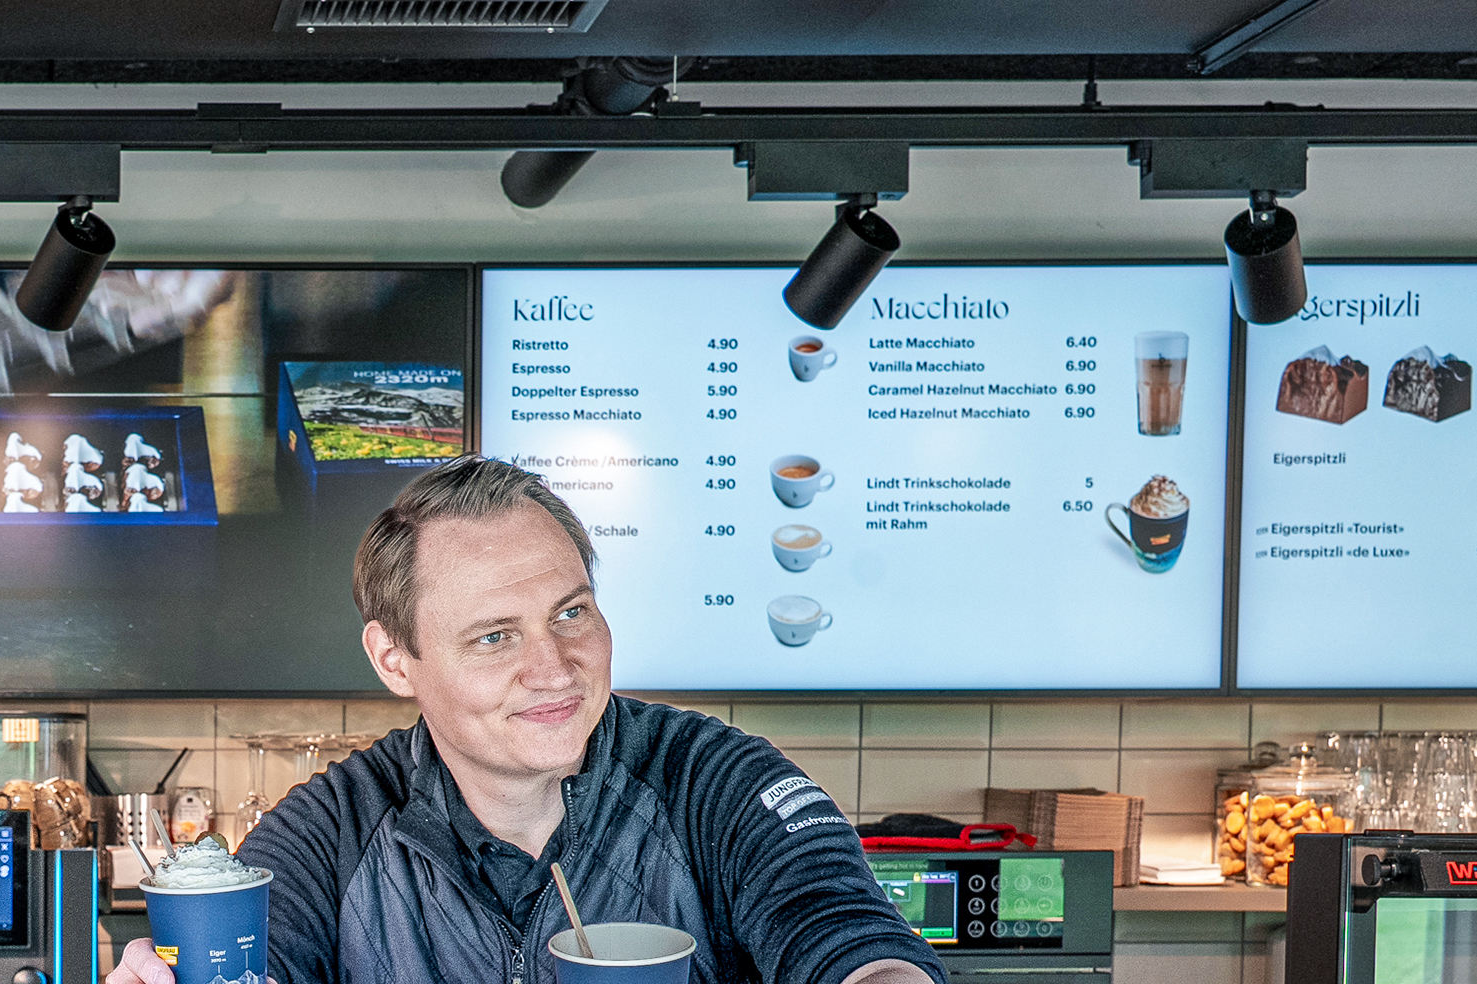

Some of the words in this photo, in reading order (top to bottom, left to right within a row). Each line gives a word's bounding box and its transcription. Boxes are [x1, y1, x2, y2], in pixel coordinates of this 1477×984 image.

[513, 295, 595, 321] Kaffee
[871, 294, 1009, 320] Macchiato
[1292, 291, 1420, 325] gerspitzli
[512, 339, 569, 351] Ristretto
[707, 338, 738, 350] 4.90
[869, 338, 903, 349] Latte
[906, 337, 975, 349] Macchiato
[1066, 336, 1097, 348] 6.40
[512, 363, 571, 375] Espresso
[707, 362, 738, 373] 4.90
[869, 361, 913, 372] Vanilla
[916, 360, 985, 372] Macchiato
[1066, 360, 1097, 372] 6.90
[354, 369, 393, 378] HOME
[399, 369, 436, 377] MADE
[375, 375, 449, 384] 2320m
[511, 385, 577, 398] Doppelter
[580, 386, 639, 398] Espresso
[707, 385, 737, 397] 5.90
[868, 384, 923, 396] Caramel
[927, 384, 985, 396] Hazelnut
[988, 384, 1057, 396] Macchiato
[1065, 384, 1096, 395] 6.90
[511, 410, 570, 422] Espresso
[573, 409, 642, 421] Macchiato
[706, 409, 737, 420] 4.90
[868, 407, 897, 419] Iced
[900, 407, 958, 419] Hazelnut
[961, 407, 1030, 419] Macchiato
[1064, 407, 1095, 418] 6.90
[706, 455, 736, 467] 4.90
[1273, 452, 1346, 467] Eigerspitzli
[705, 479, 736, 490] 4.90
[867, 477, 900, 489] Lindt
[903, 477, 1011, 489] Trinkschokolade
[1085, 477, 1093, 489] 5
[866, 501, 899, 512] Lindt
[903, 500, 1011, 512] Trinkschokolade
[1063, 500, 1093, 512] 6.50
[866, 518, 887, 530] mit
[890, 518, 927, 530] Rahm
[1271, 522, 1344, 537] Eigerspitzli
[704, 525, 735, 536] 4.90
[1270, 546, 1343, 560] Eigerspitzli
[704, 595, 734, 606] 5.90
